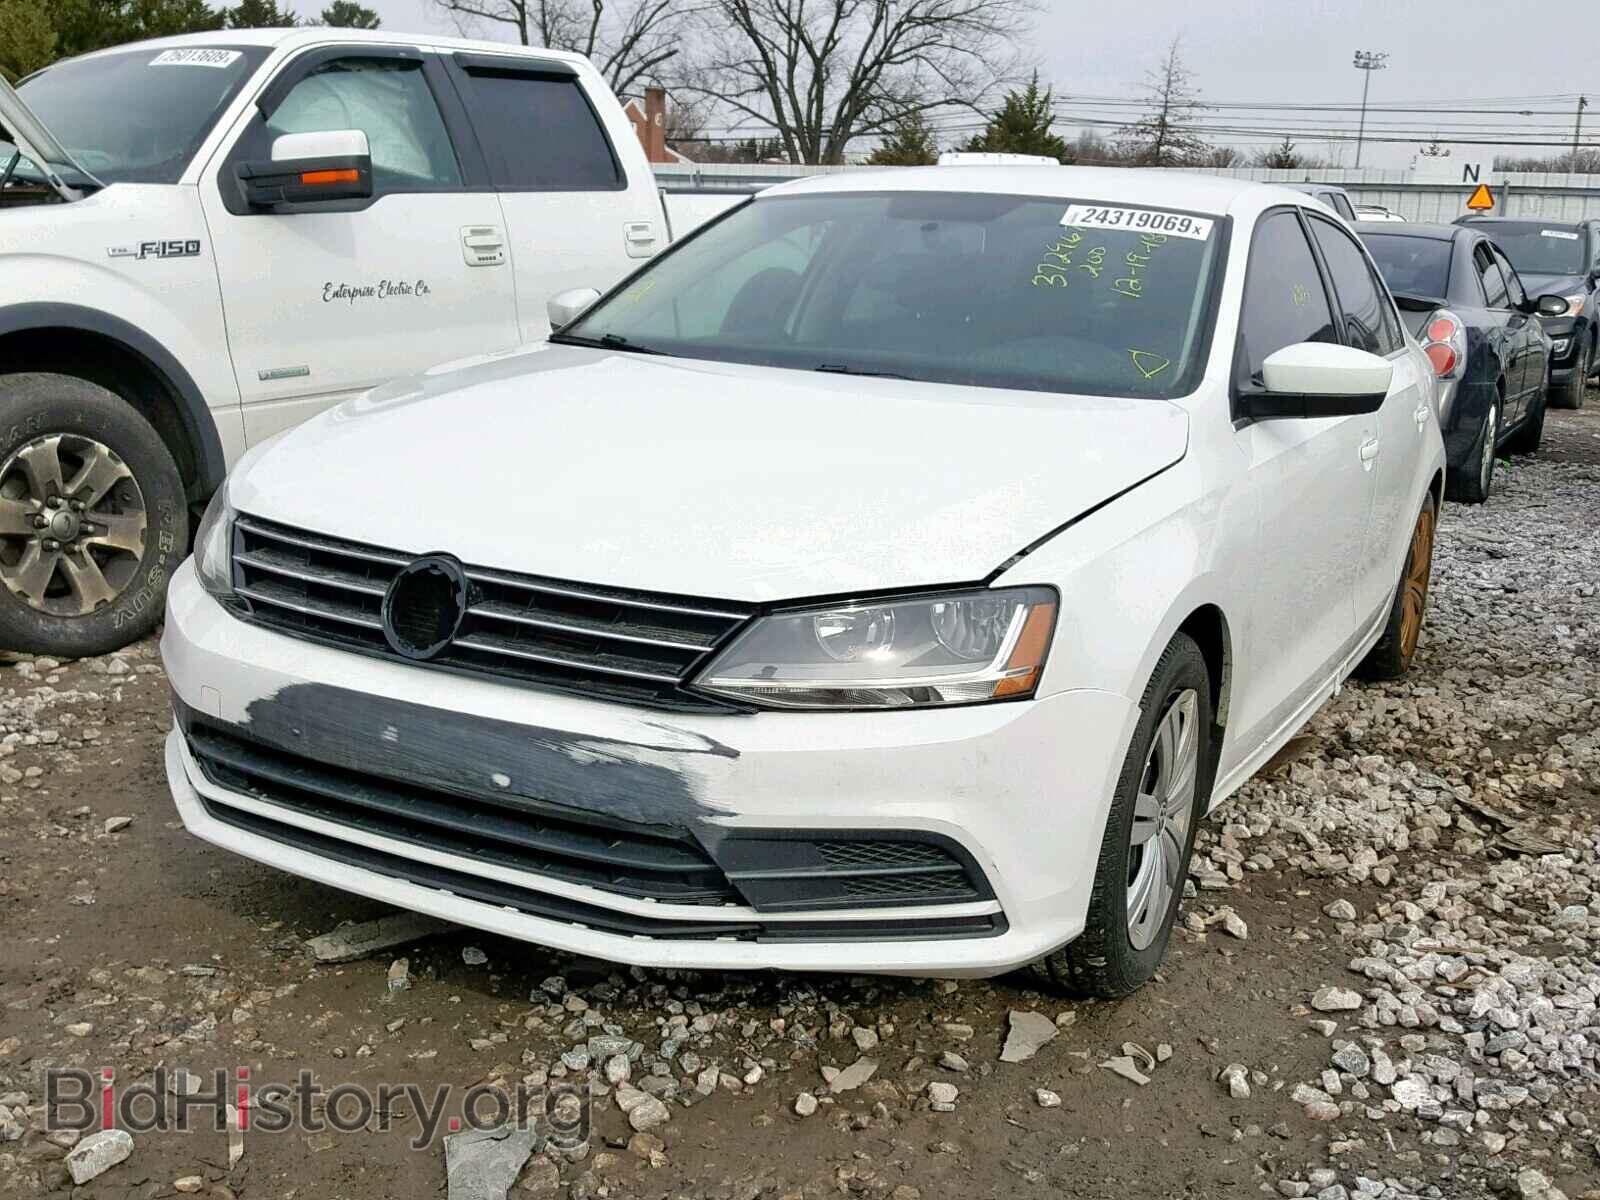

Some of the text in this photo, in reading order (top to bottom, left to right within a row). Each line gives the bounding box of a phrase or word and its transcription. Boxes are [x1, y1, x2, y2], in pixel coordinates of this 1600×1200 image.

[1462, 163, 1480, 183] N
[322, 279, 431, 304] Enterprise Electric Co.
